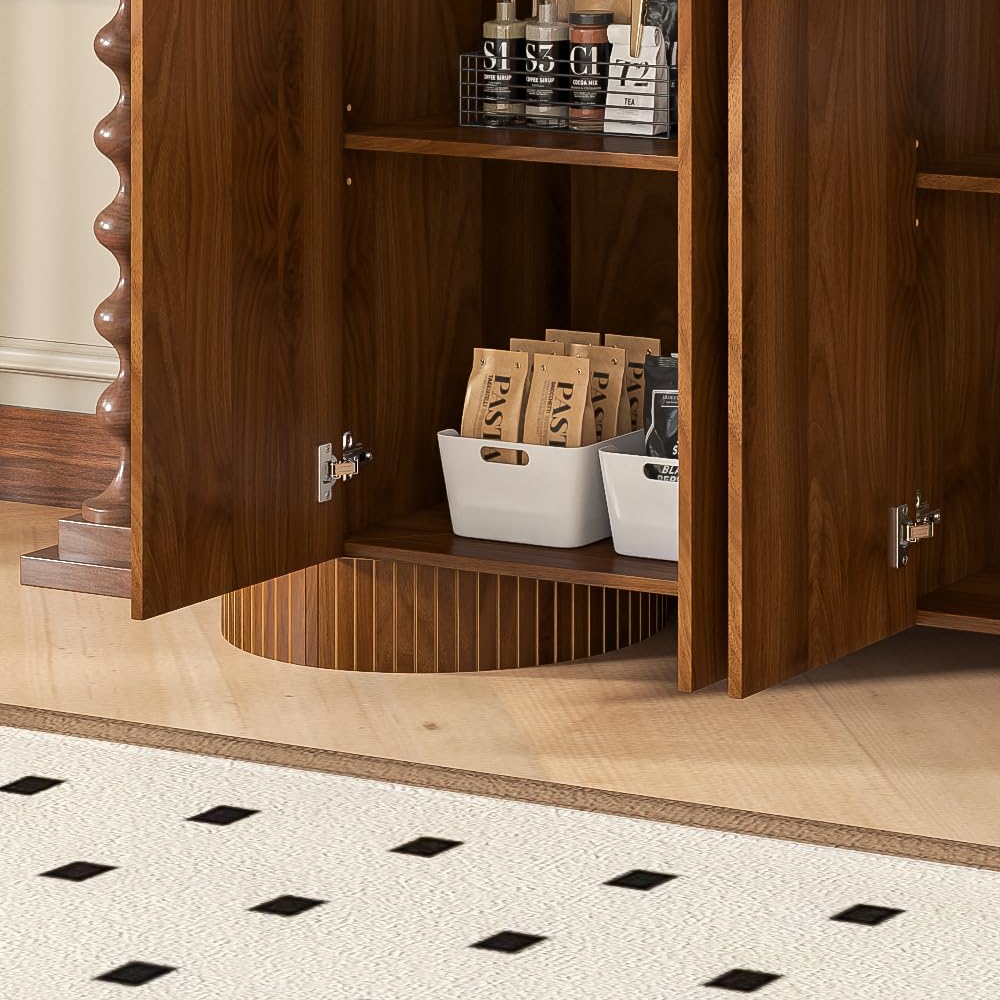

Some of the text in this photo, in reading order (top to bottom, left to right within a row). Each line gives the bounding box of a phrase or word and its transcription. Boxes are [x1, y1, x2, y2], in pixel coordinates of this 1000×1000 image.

[483, 40, 511, 71] S1
[525, 43, 555, 73] S3
[570, 45, 601, 76] C1
[624, 98, 636, 106] TEA
[590, 371, 610, 441] PAST
[626, 362, 644, 431] PAST
[548, 381, 575, 448] PAST
